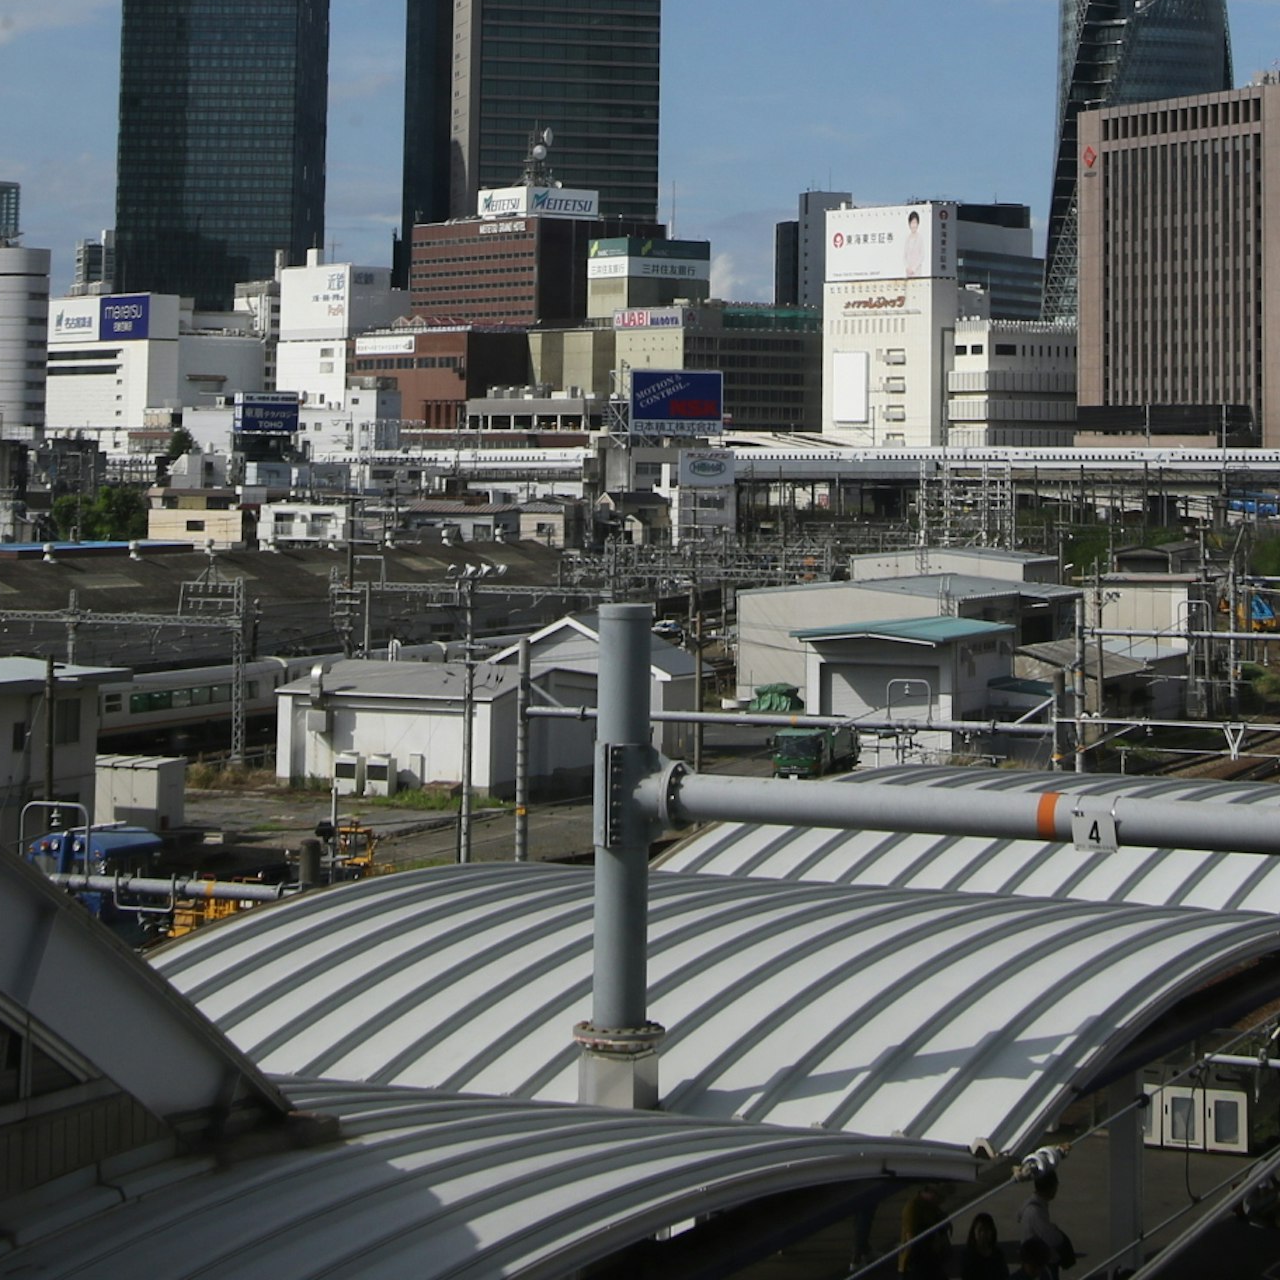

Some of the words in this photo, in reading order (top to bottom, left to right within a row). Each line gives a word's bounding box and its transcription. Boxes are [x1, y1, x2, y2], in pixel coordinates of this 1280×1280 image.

[482, 191, 520, 212] MEITETSU
[531, 190, 593, 212] MEITETSU
[846, 232, 893, 244] 東海東京証券
[591, 264, 625, 275] 三井住友銀行
[642, 264, 696, 276] 三井住友銀行
[328, 272, 345, 291] 近鉄
[622, 311, 651, 327] LABI
[635, 375, 674, 400] MOTION
[640, 382, 686, 408] CONTROL
[669, 399, 720, 417] NSK
[634, 421, 717, 432] 日本精工株式会社
[1089, 820, 1101, 844] 4
